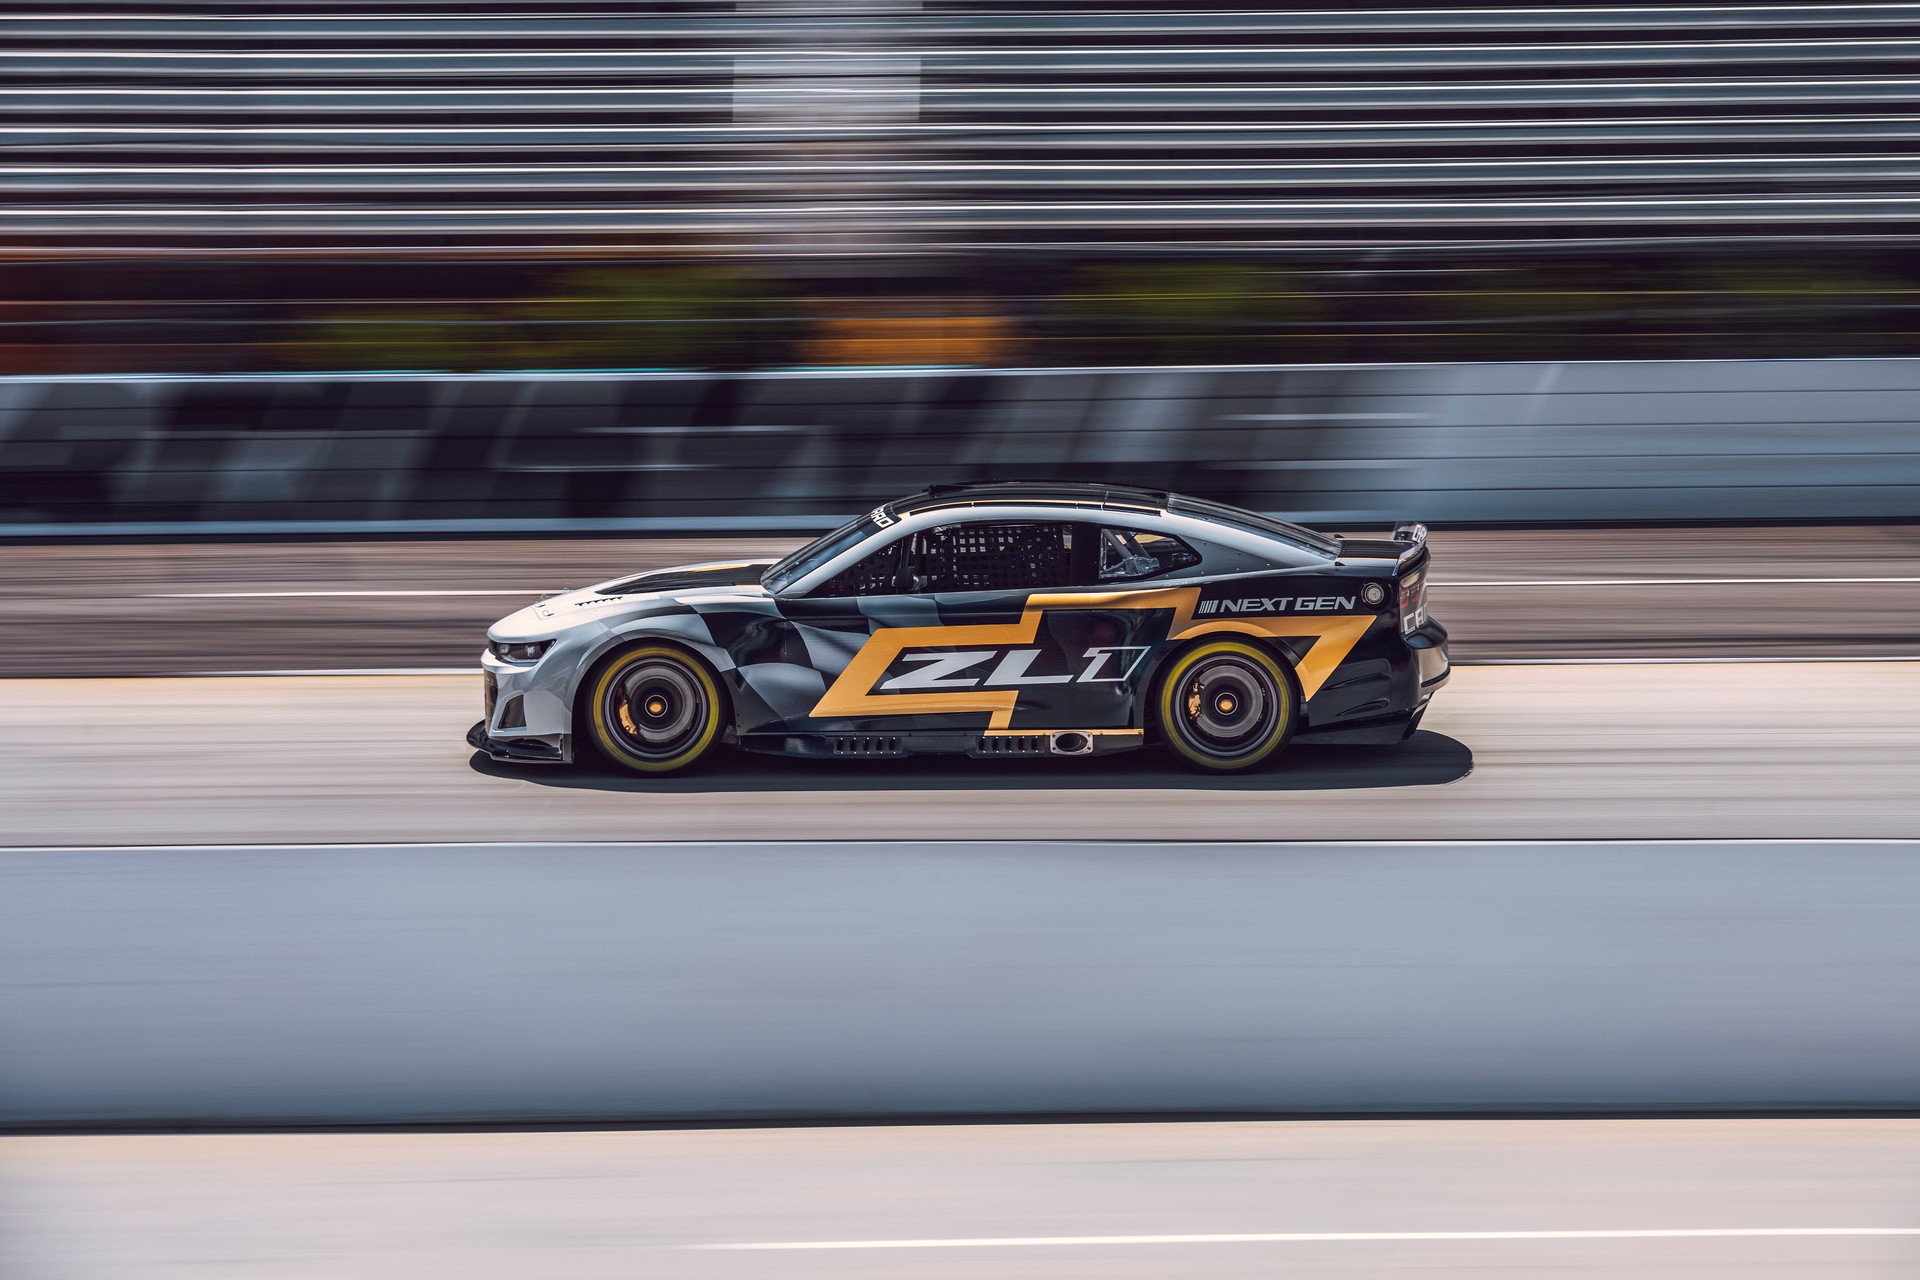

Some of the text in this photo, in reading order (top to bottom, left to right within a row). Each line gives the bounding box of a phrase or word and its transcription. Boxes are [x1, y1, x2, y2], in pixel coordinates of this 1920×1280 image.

[1220, 596, 1356, 613] NEXT GEN
[1403, 605, 1427, 635] CA
[880, 646, 1151, 690] ZL1
